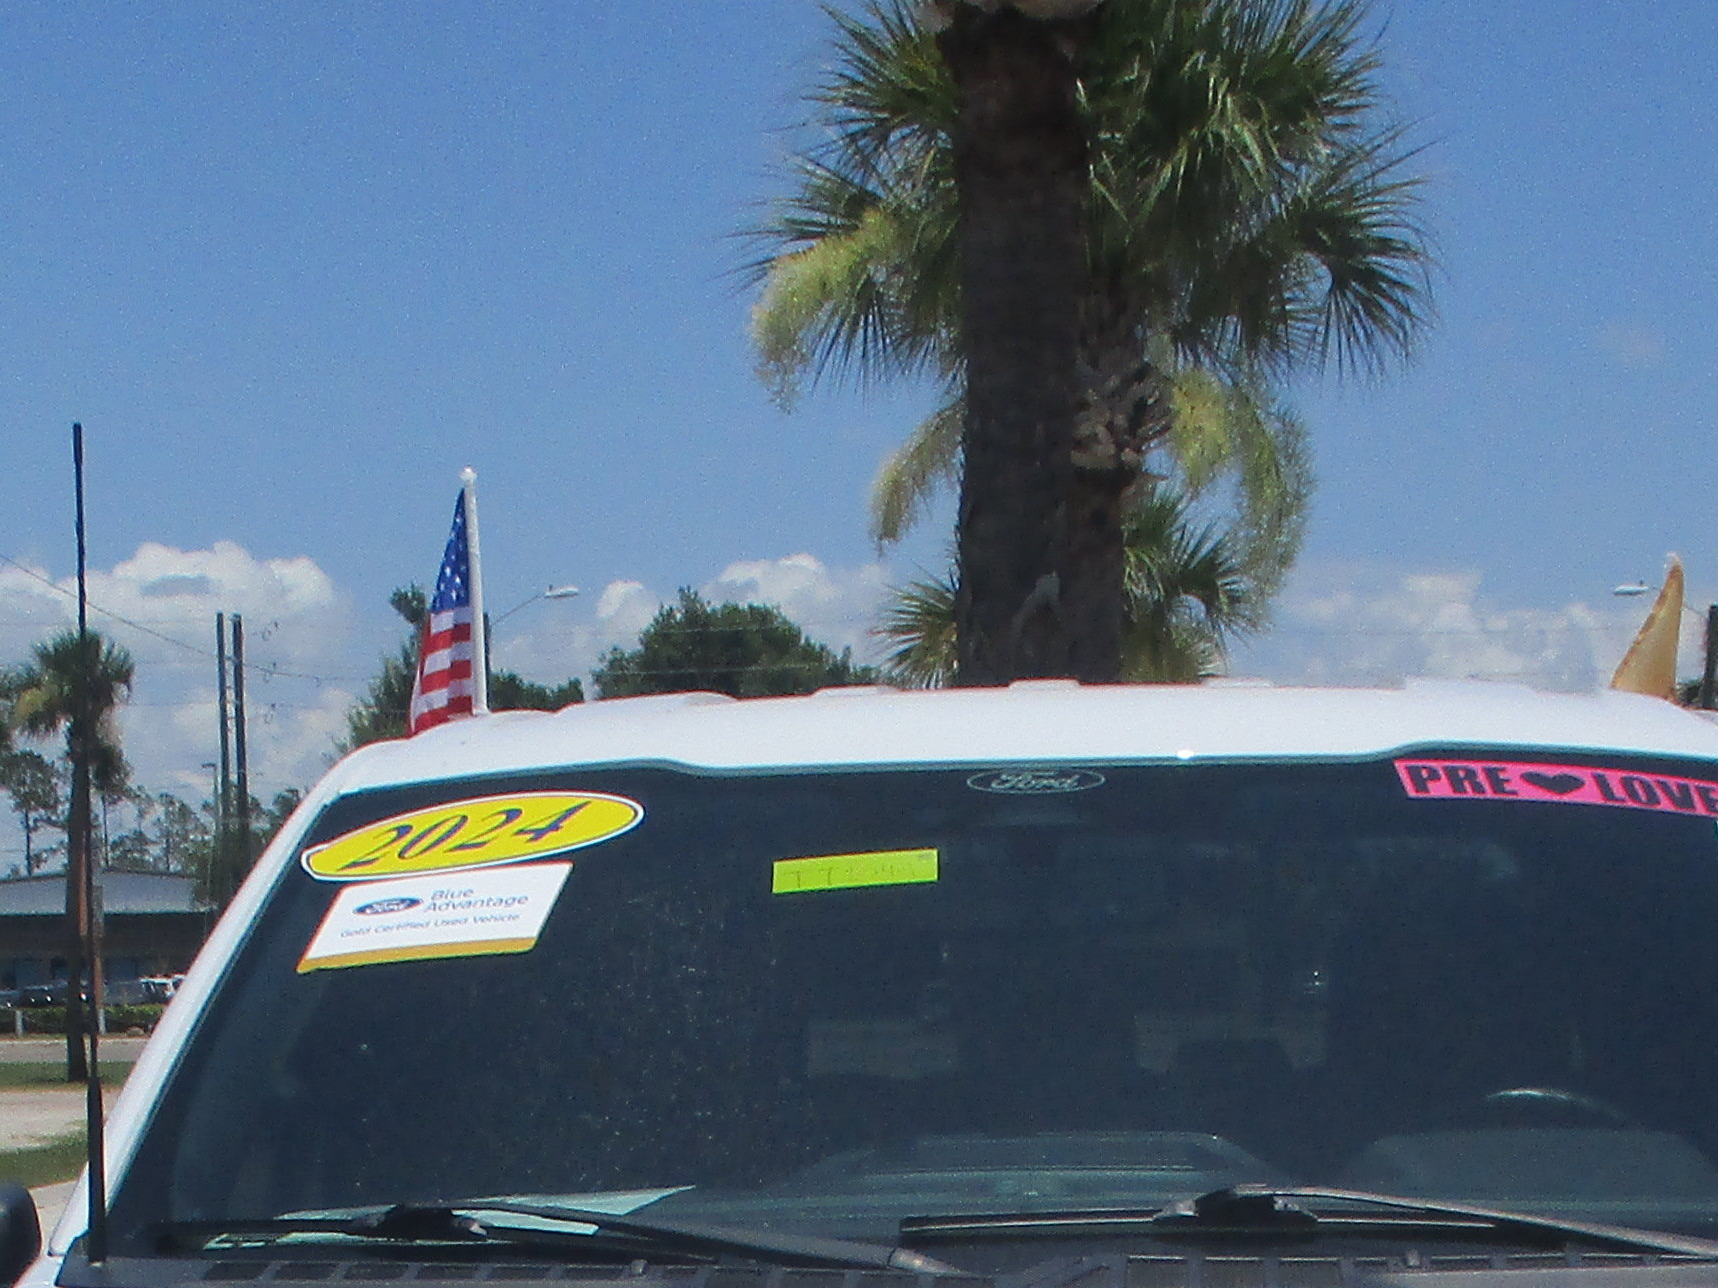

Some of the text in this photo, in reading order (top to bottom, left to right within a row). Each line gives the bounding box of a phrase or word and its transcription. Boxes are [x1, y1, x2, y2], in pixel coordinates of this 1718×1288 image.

[991, 772, 1080, 790] Ford
[1406, 765, 1519, 796] PRE
[336, 799, 592, 872] 2024
[423, 895, 530, 913] Advantage
[430, 888, 475, 901] Blue
[339, 912, 521, 938] Gold Certified Used Vehicle
